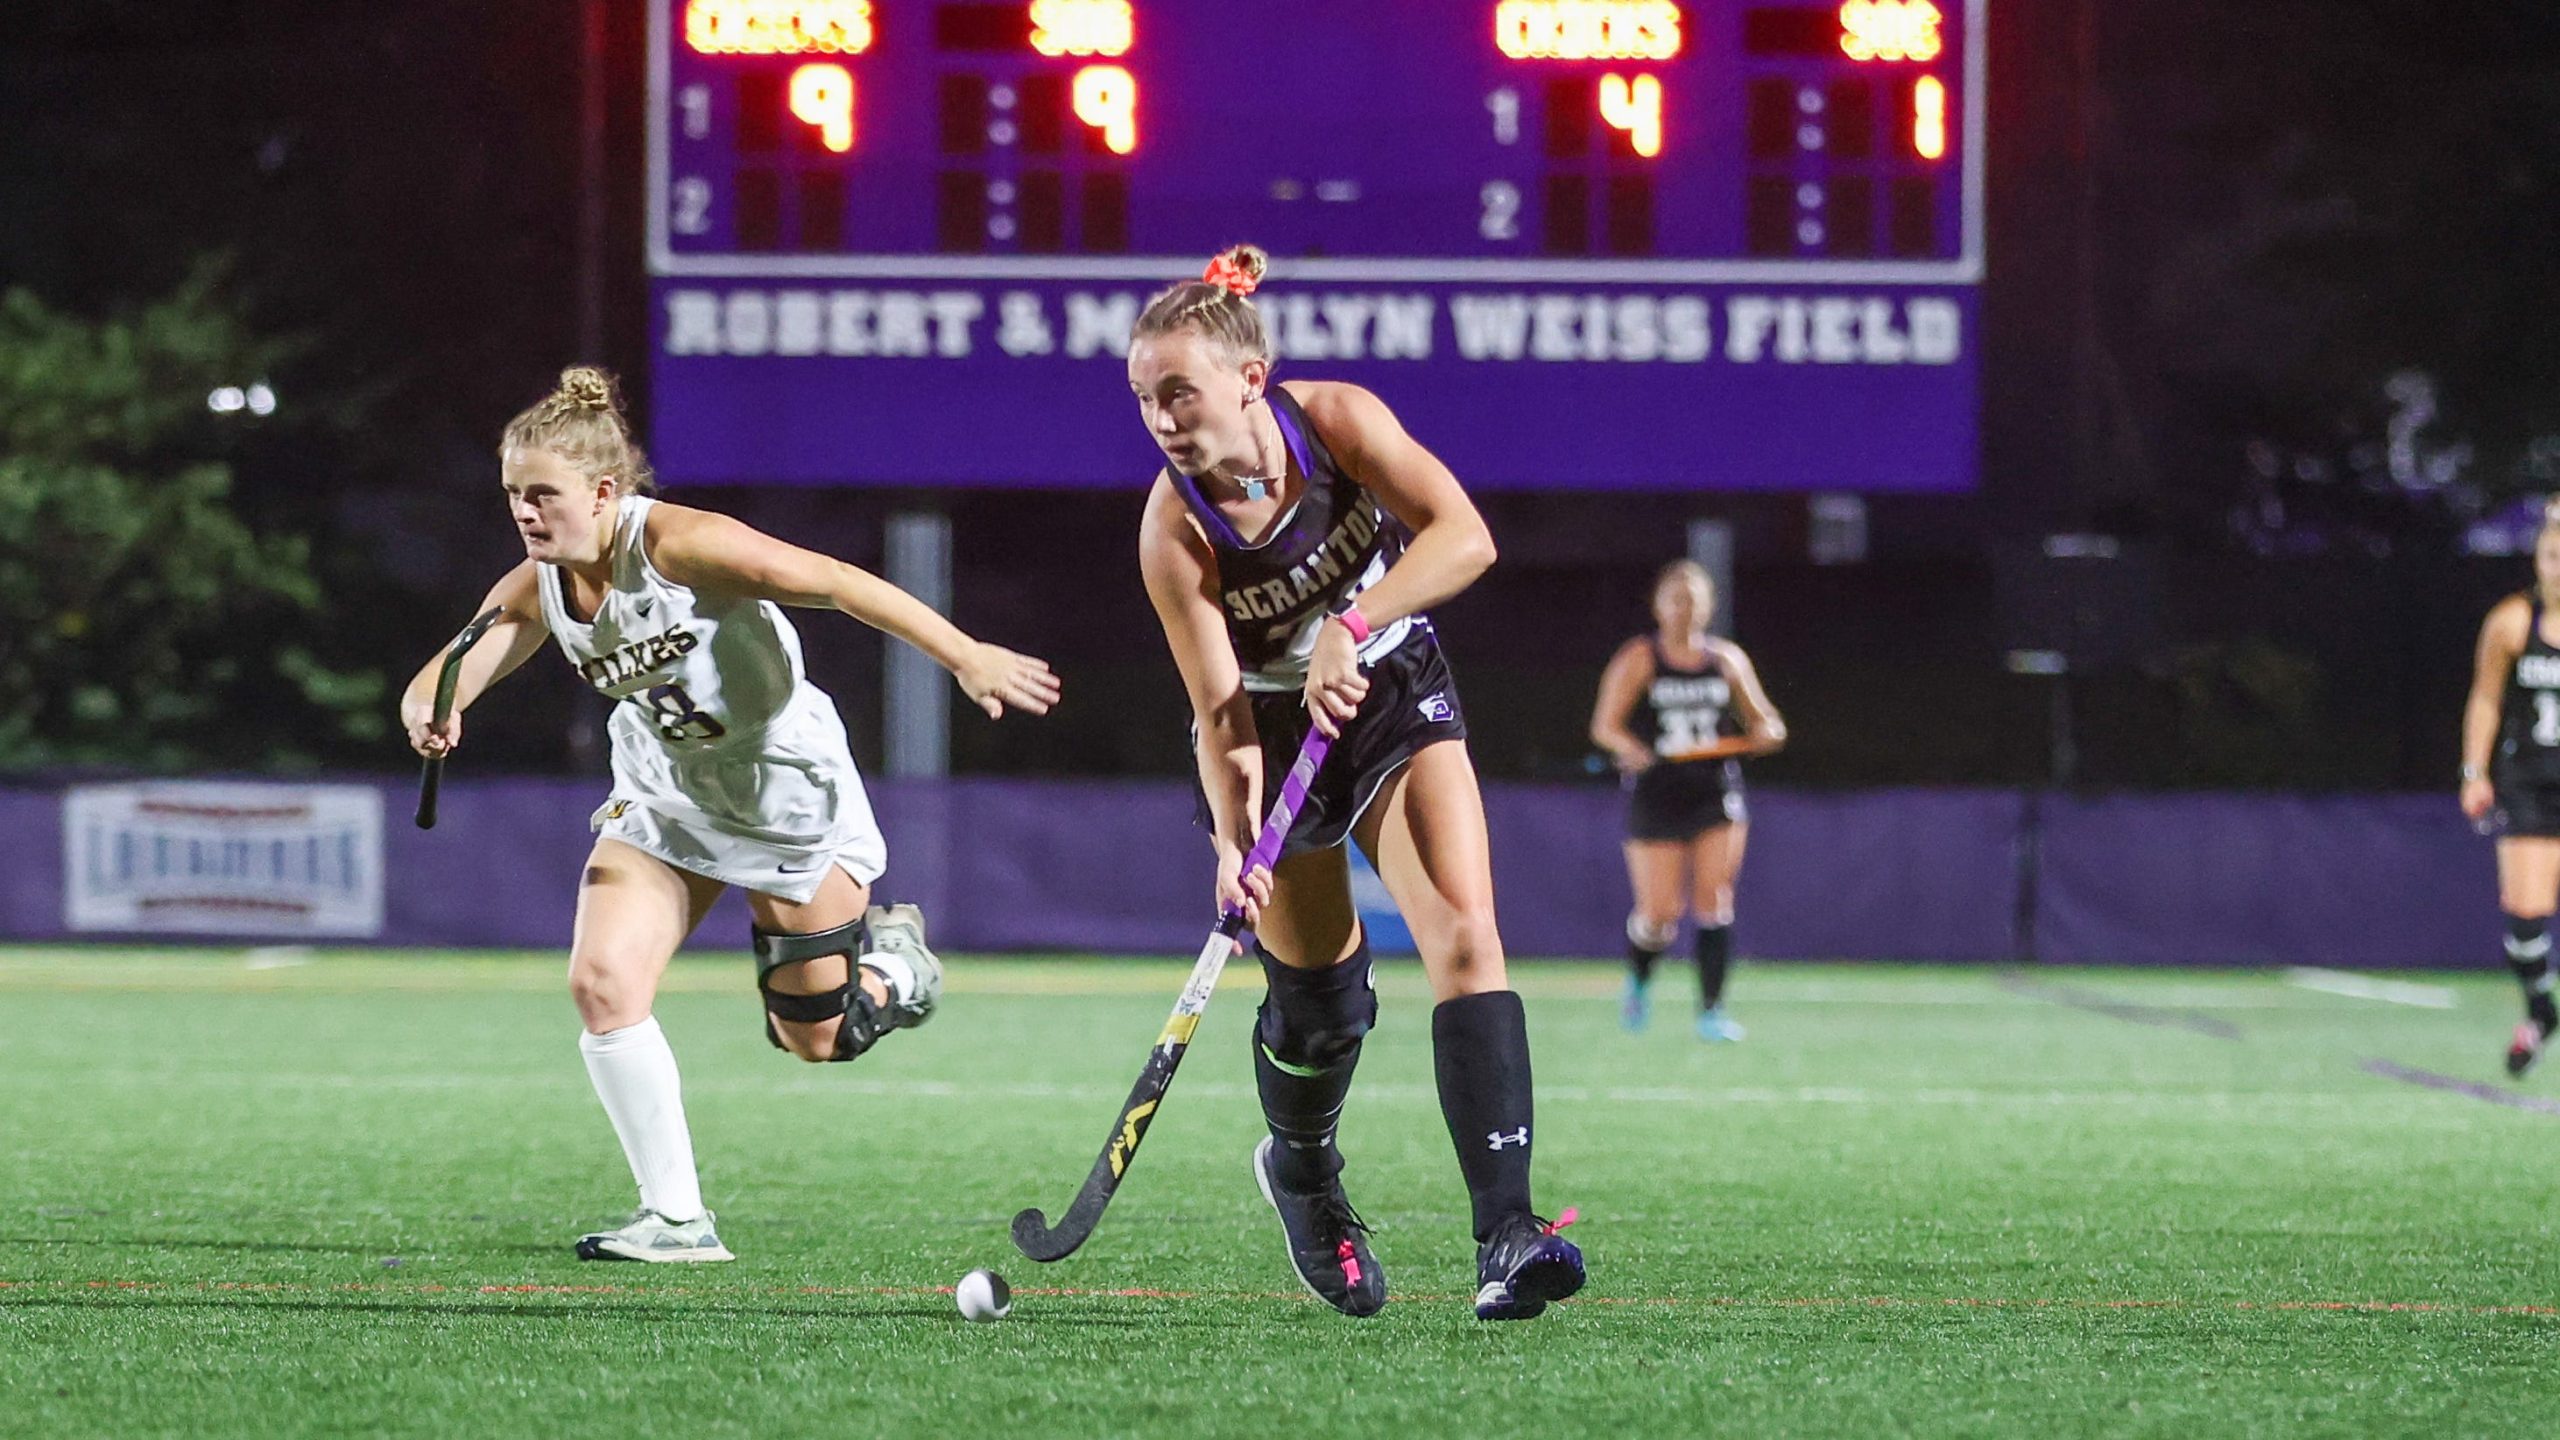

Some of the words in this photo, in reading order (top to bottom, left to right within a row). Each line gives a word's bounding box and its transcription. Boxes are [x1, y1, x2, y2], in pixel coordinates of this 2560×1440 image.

[790, 64, 852, 152] 9
[1073, 65, 1135, 154] 9
[1600, 73, 1661, 157] 4
[1914, 75, 1944, 159] 1
[666, 289, 982, 357] ROBERT
[996, 290, 1052, 356] &
[1063, 291, 1432, 359] MILYN
[1450, 294, 1708, 360] WEISS
[1725, 294, 1959, 363] FIELD
[1225, 488, 1380, 621] SCRANTON
